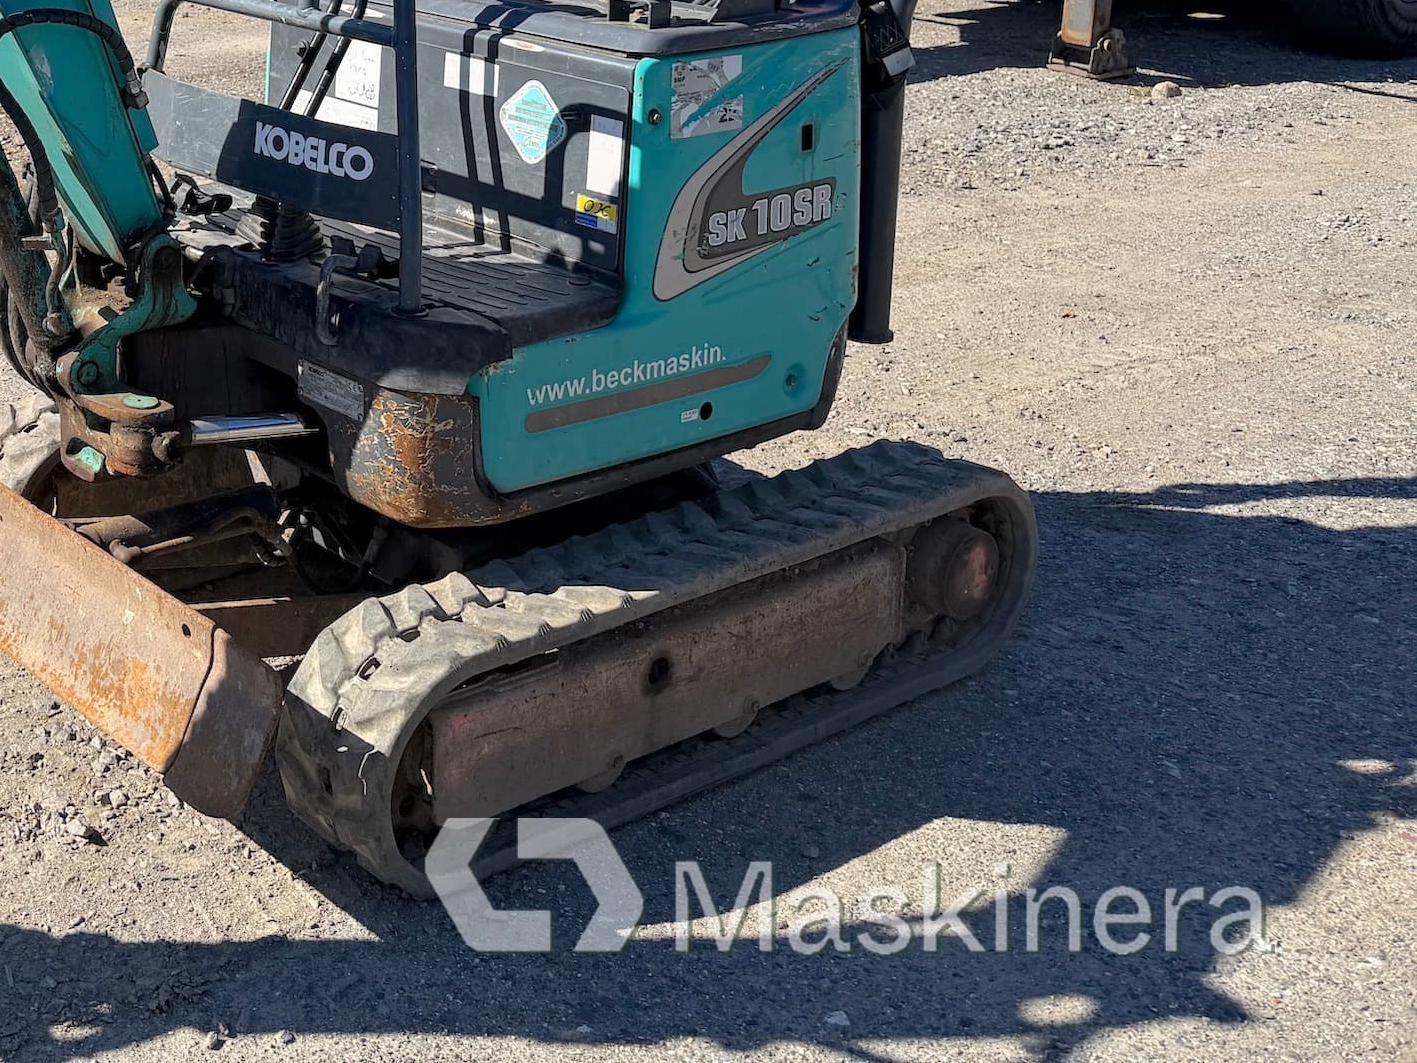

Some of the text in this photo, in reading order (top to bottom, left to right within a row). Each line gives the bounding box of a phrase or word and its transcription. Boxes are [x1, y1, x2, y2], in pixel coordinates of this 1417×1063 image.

[254, 121, 374, 181] KOBELCO
[708, 184, 832, 247] SK 10SR
[526, 342, 727, 406] www.beckmaskin.
